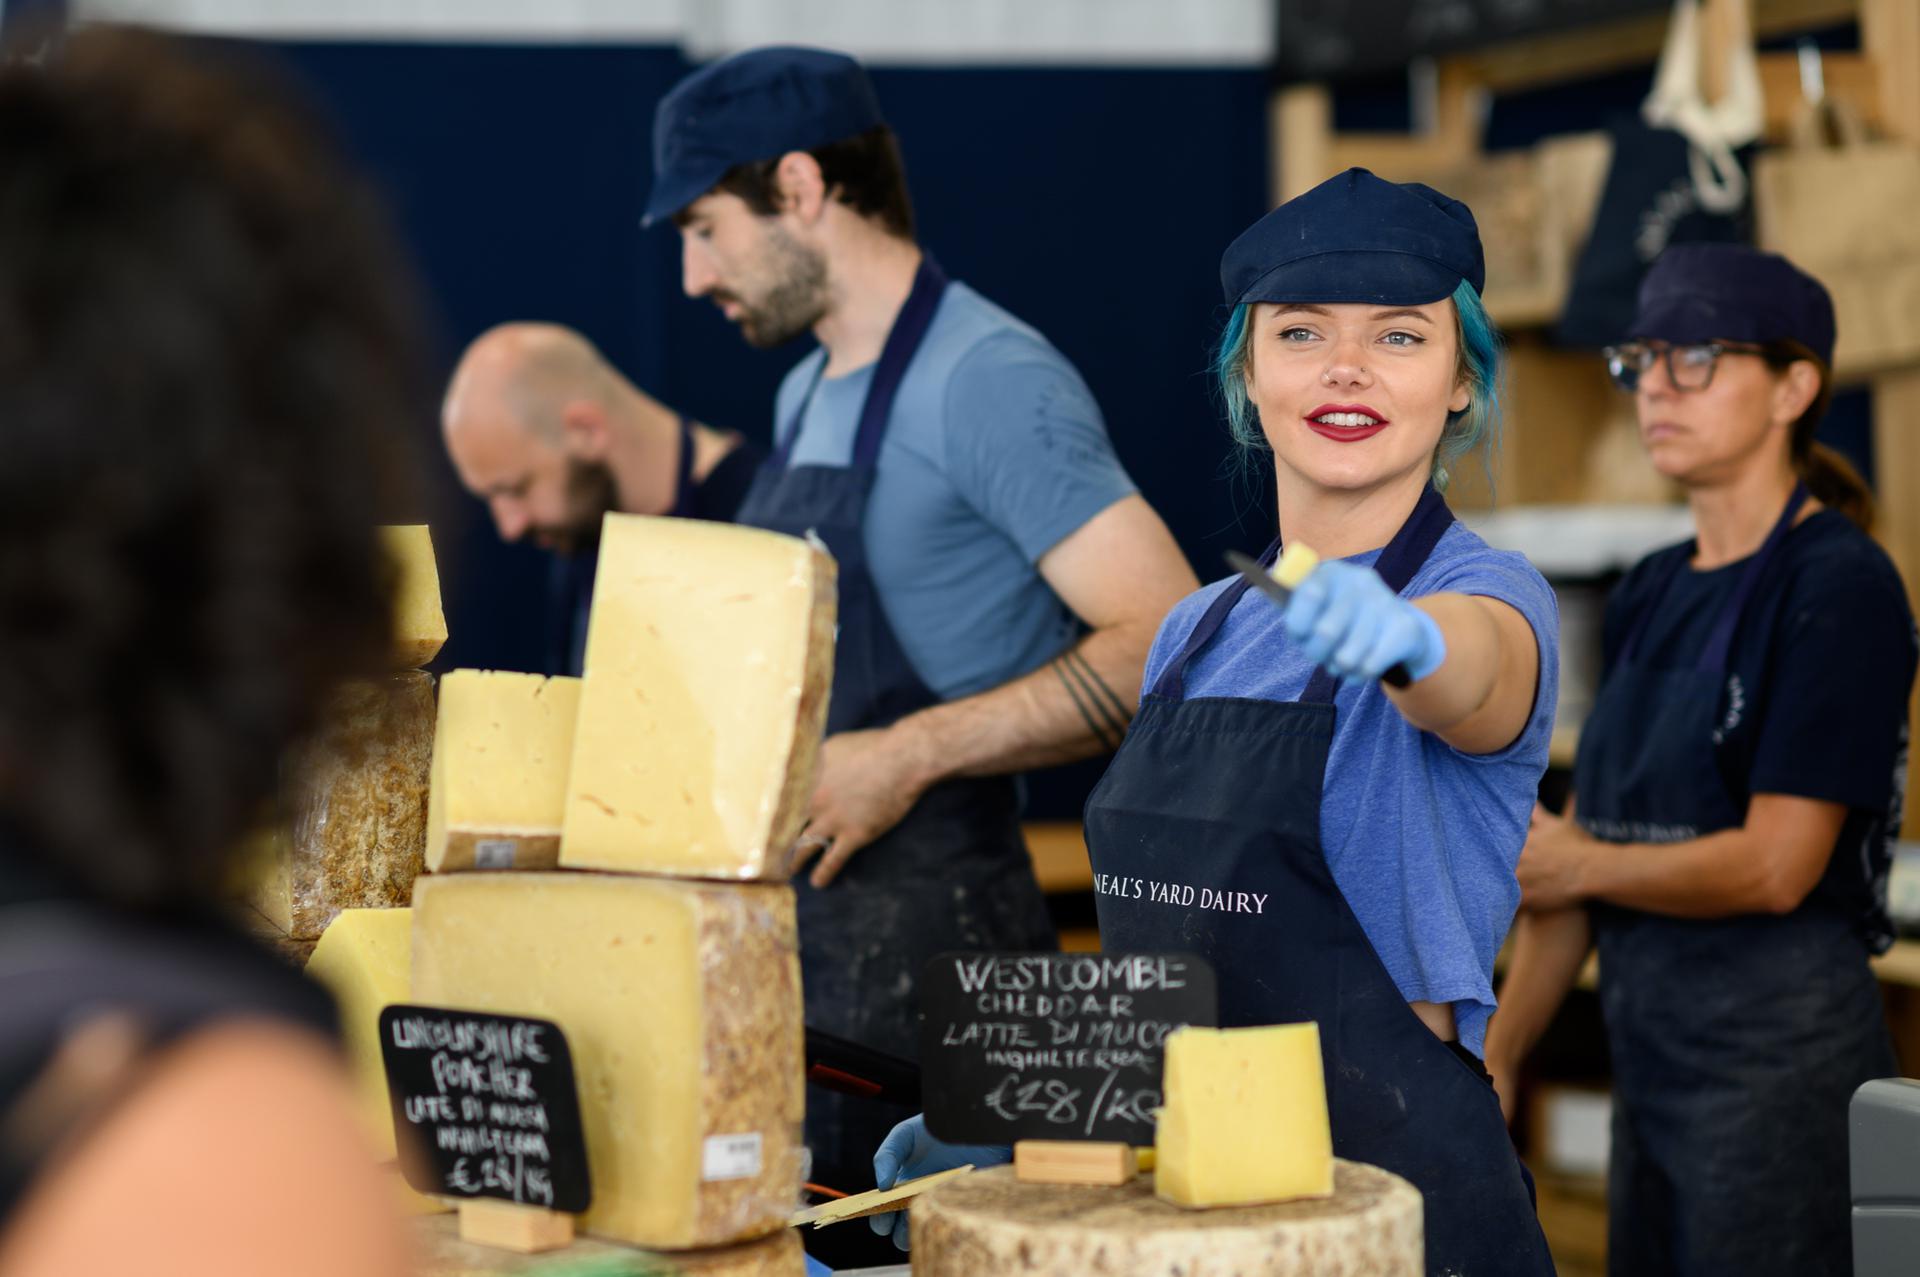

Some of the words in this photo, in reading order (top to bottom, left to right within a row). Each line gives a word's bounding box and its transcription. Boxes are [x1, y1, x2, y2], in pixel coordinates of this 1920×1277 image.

[1094, 873, 1143, 899] NEAL'S
[1149, 881, 1194, 907] YARD
[1200, 888, 1269, 914] DAIRY
[955, 956, 1187, 992] WESTCOMBE
[977, 992, 1134, 1017] CHEDDAR
[943, 1021, 1038, 1047] LATTE
[1049, 1019, 1077, 1045] DI
[1087, 1021, 1188, 1047] MUCC
[431, 1051, 538, 1100] POACHER
